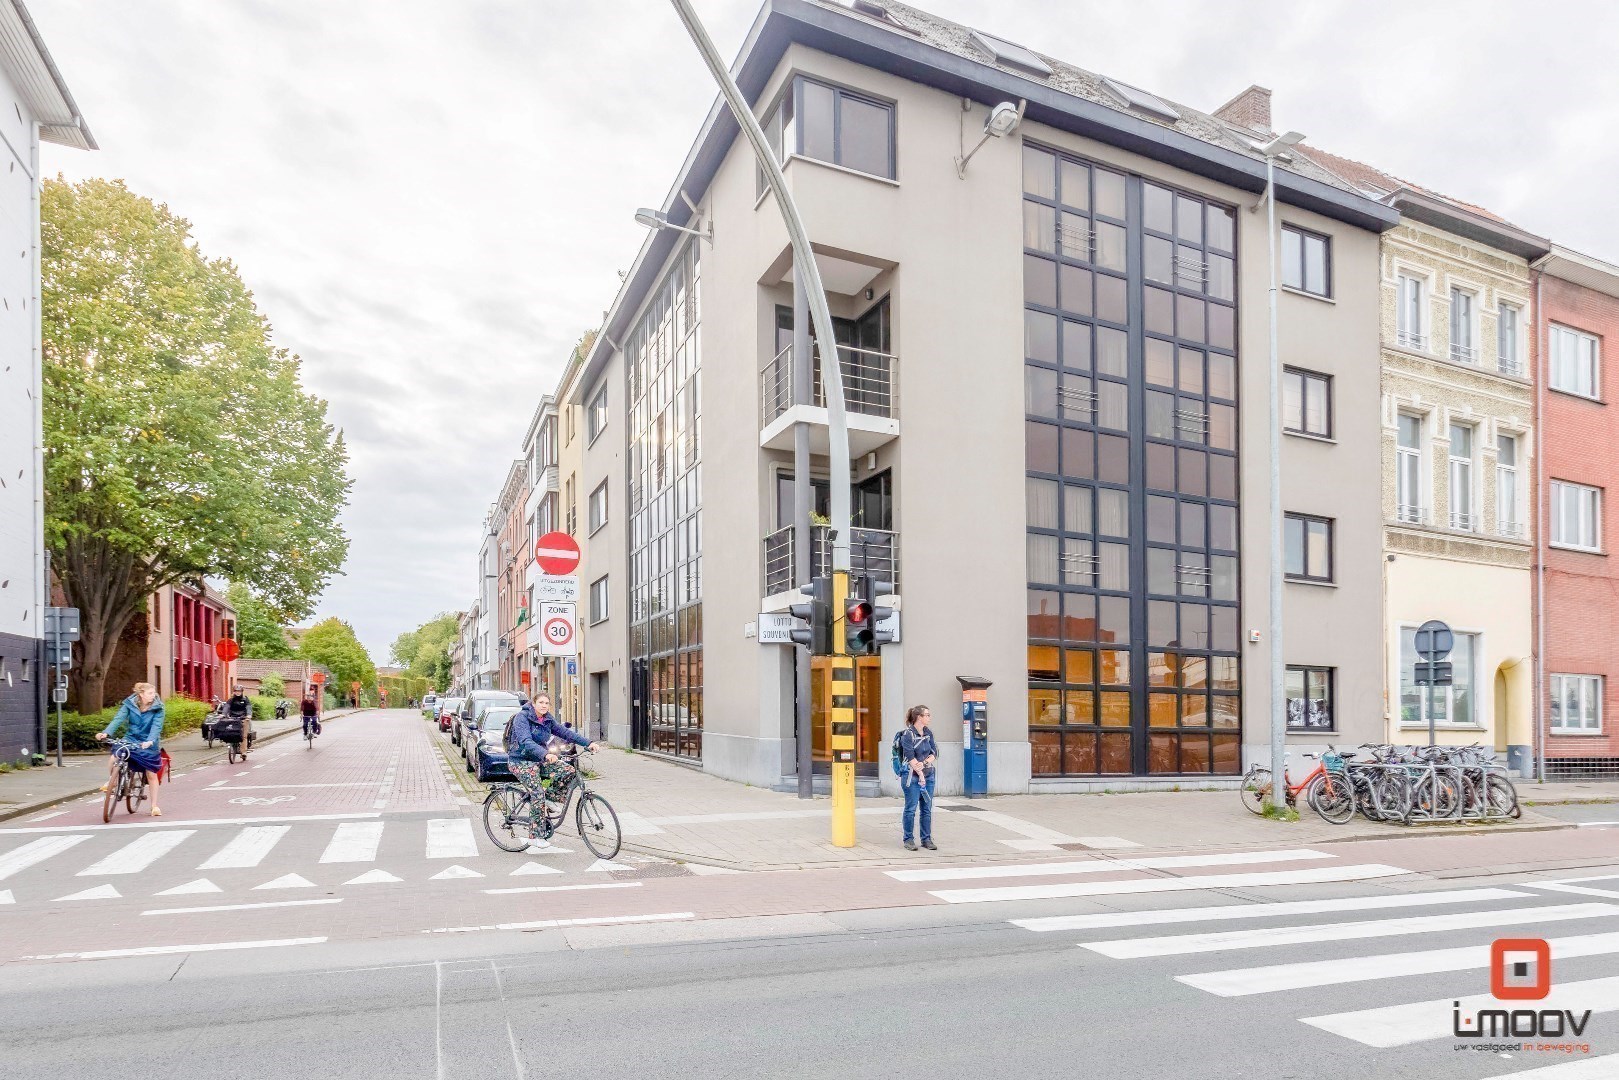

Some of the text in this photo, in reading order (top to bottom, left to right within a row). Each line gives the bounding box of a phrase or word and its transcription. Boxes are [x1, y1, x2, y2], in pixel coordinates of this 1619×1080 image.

[773, 618, 792, 626] LOTTO
[551, 626, 566, 636] 30
[762, 630, 790, 638] SOUVENI
